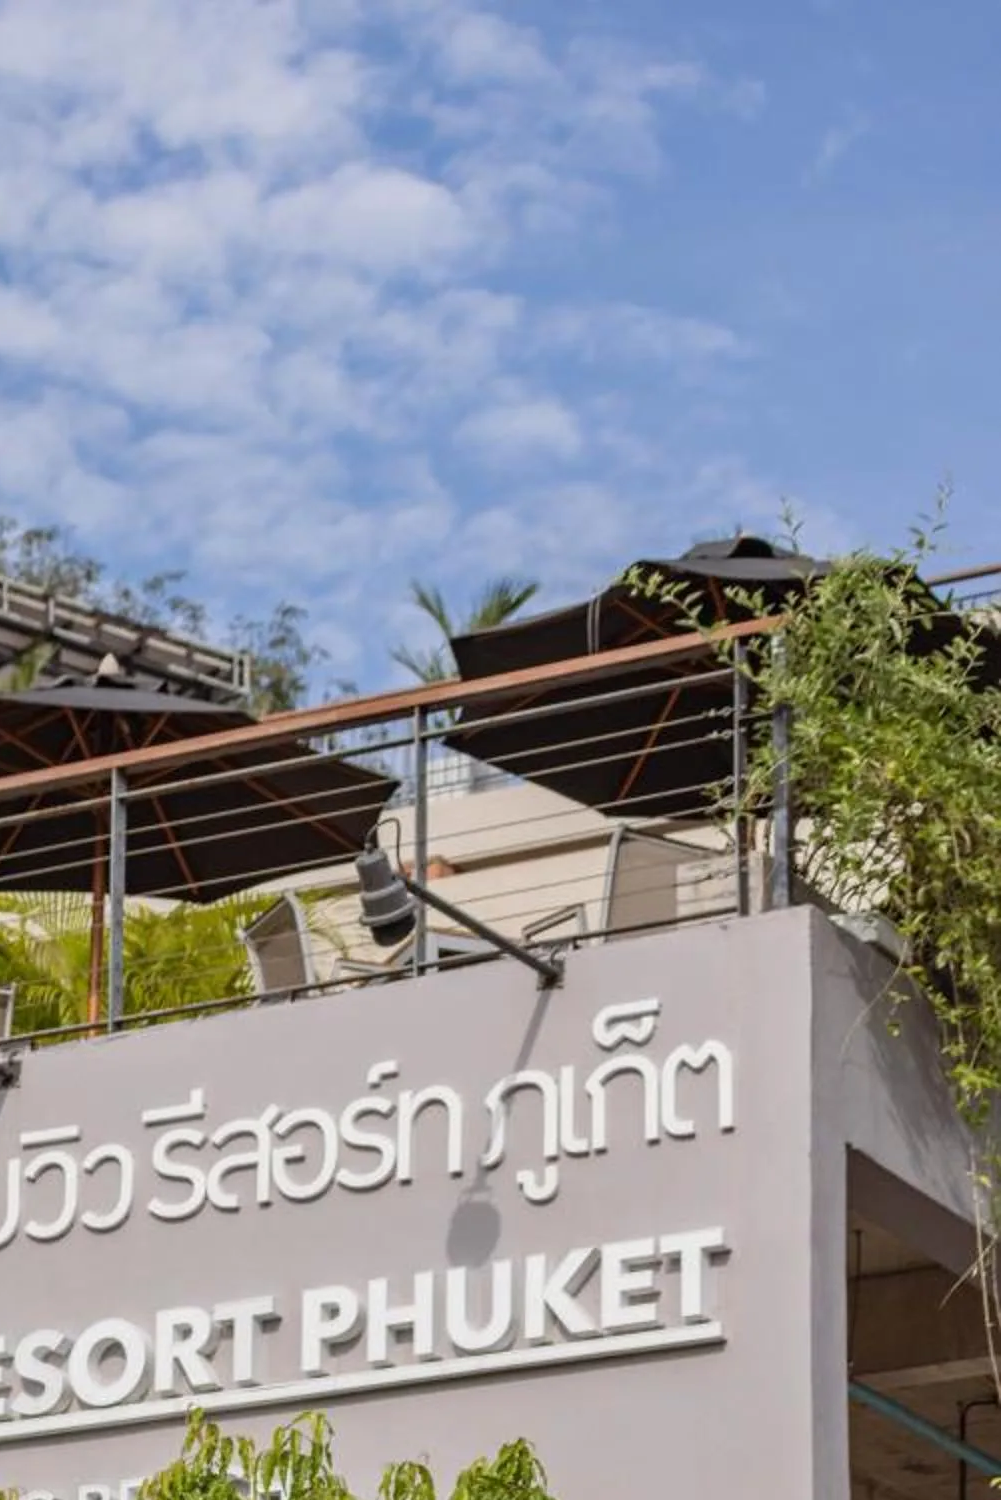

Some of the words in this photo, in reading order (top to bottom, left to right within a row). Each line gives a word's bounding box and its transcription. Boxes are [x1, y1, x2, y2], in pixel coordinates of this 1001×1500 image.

[141, 1060, 463, 1219] รีสอร์ท
[483, 998, 735, 1201] ภูเก็ต
[300, 1226, 731, 1375] PHUKET
